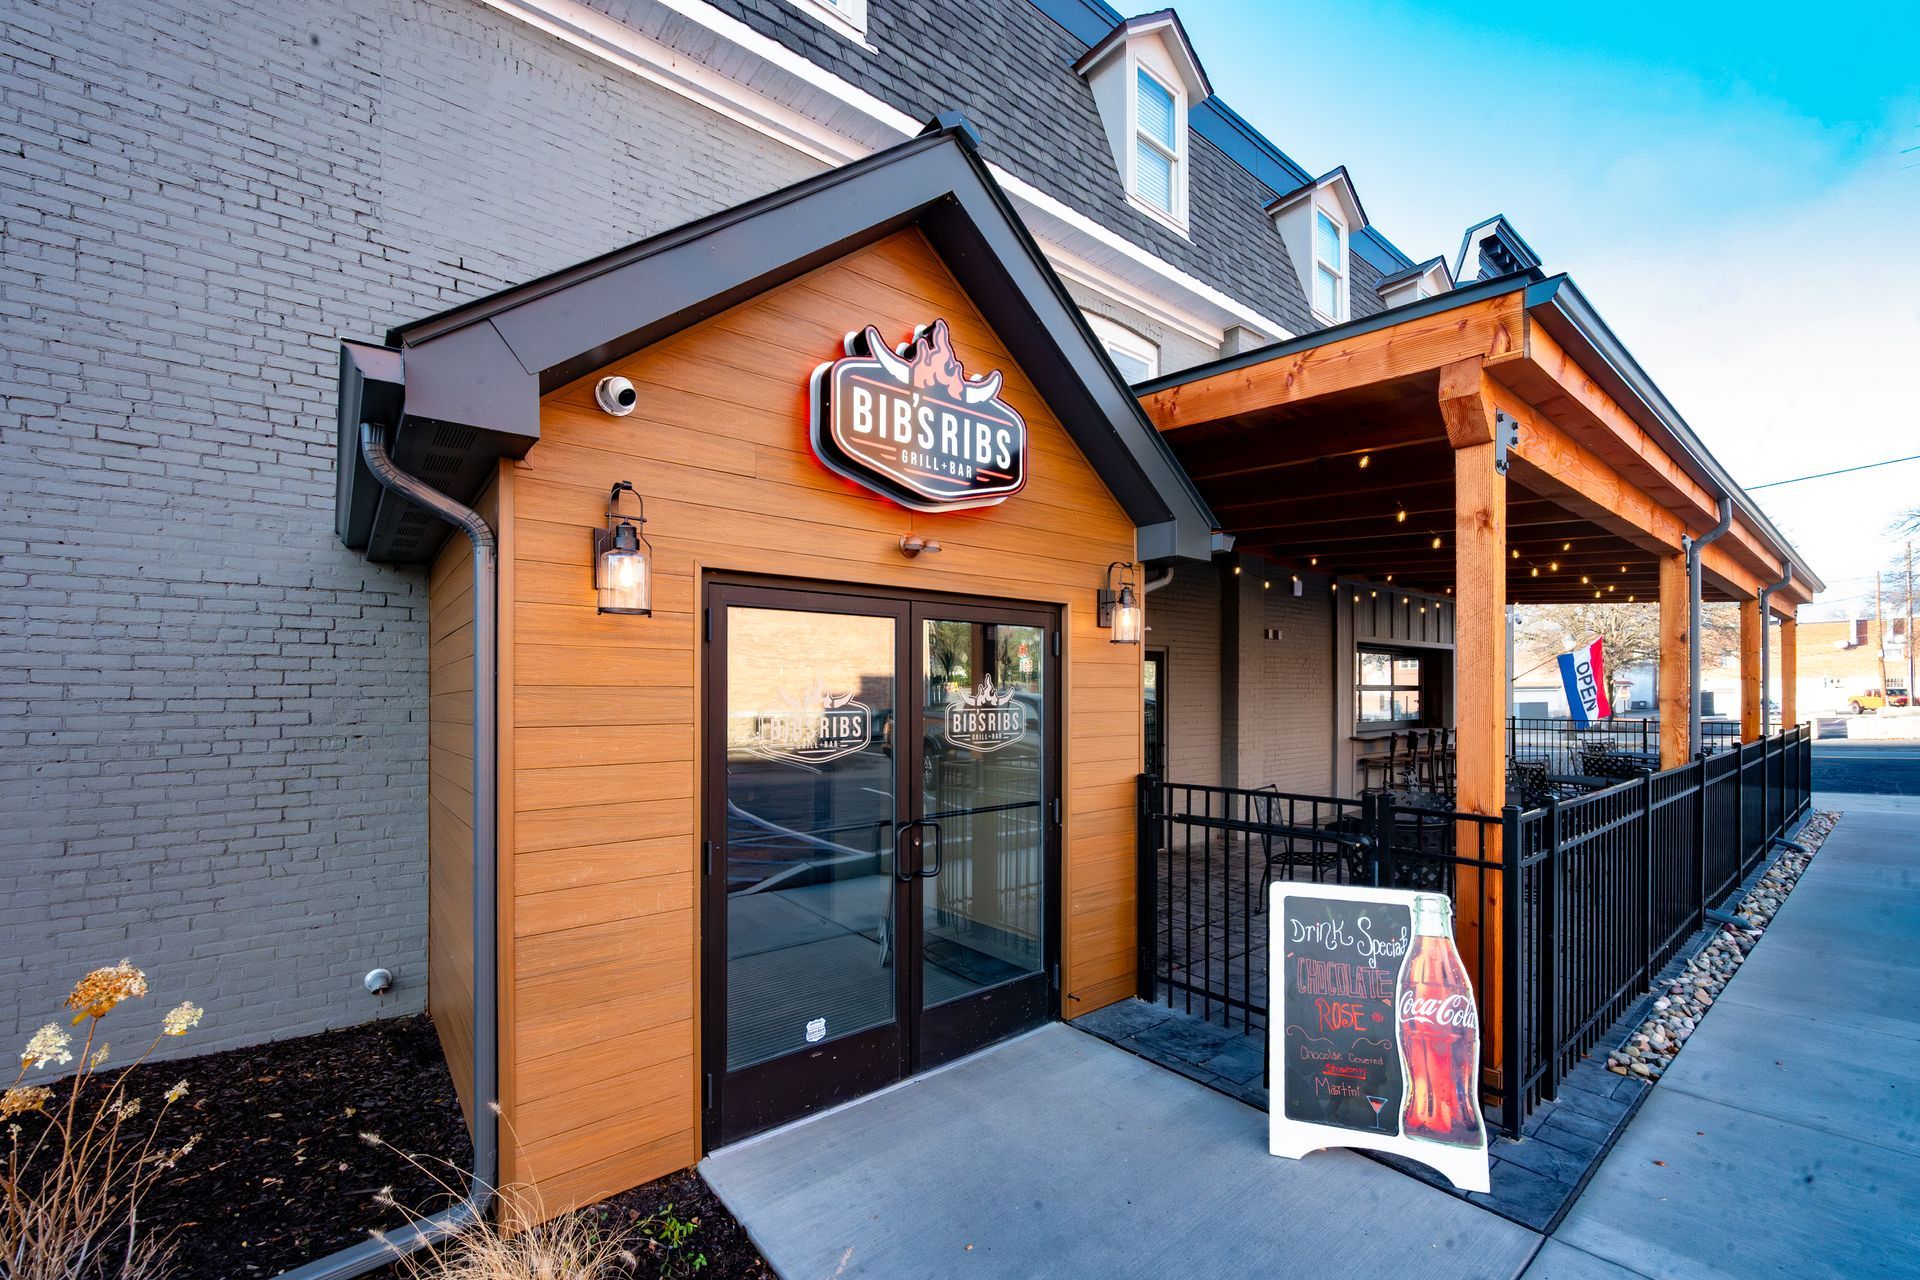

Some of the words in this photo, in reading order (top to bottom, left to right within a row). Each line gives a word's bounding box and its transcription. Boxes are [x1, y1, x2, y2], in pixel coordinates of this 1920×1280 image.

[853, 386, 935, 450] BIB'S
[941, 411, 1012, 470] RIBS
[1576, 661, 1597, 712] OPEN
[820, 715, 863, 739] RIBS
[953, 708, 986, 733] BIB'S
[988, 712, 1019, 731] RIBS
[1296, 957, 1394, 999] CHOCOLATE
[1315, 997, 1369, 1032] ROSE
[1315, 1076, 1361, 1097] Martini
